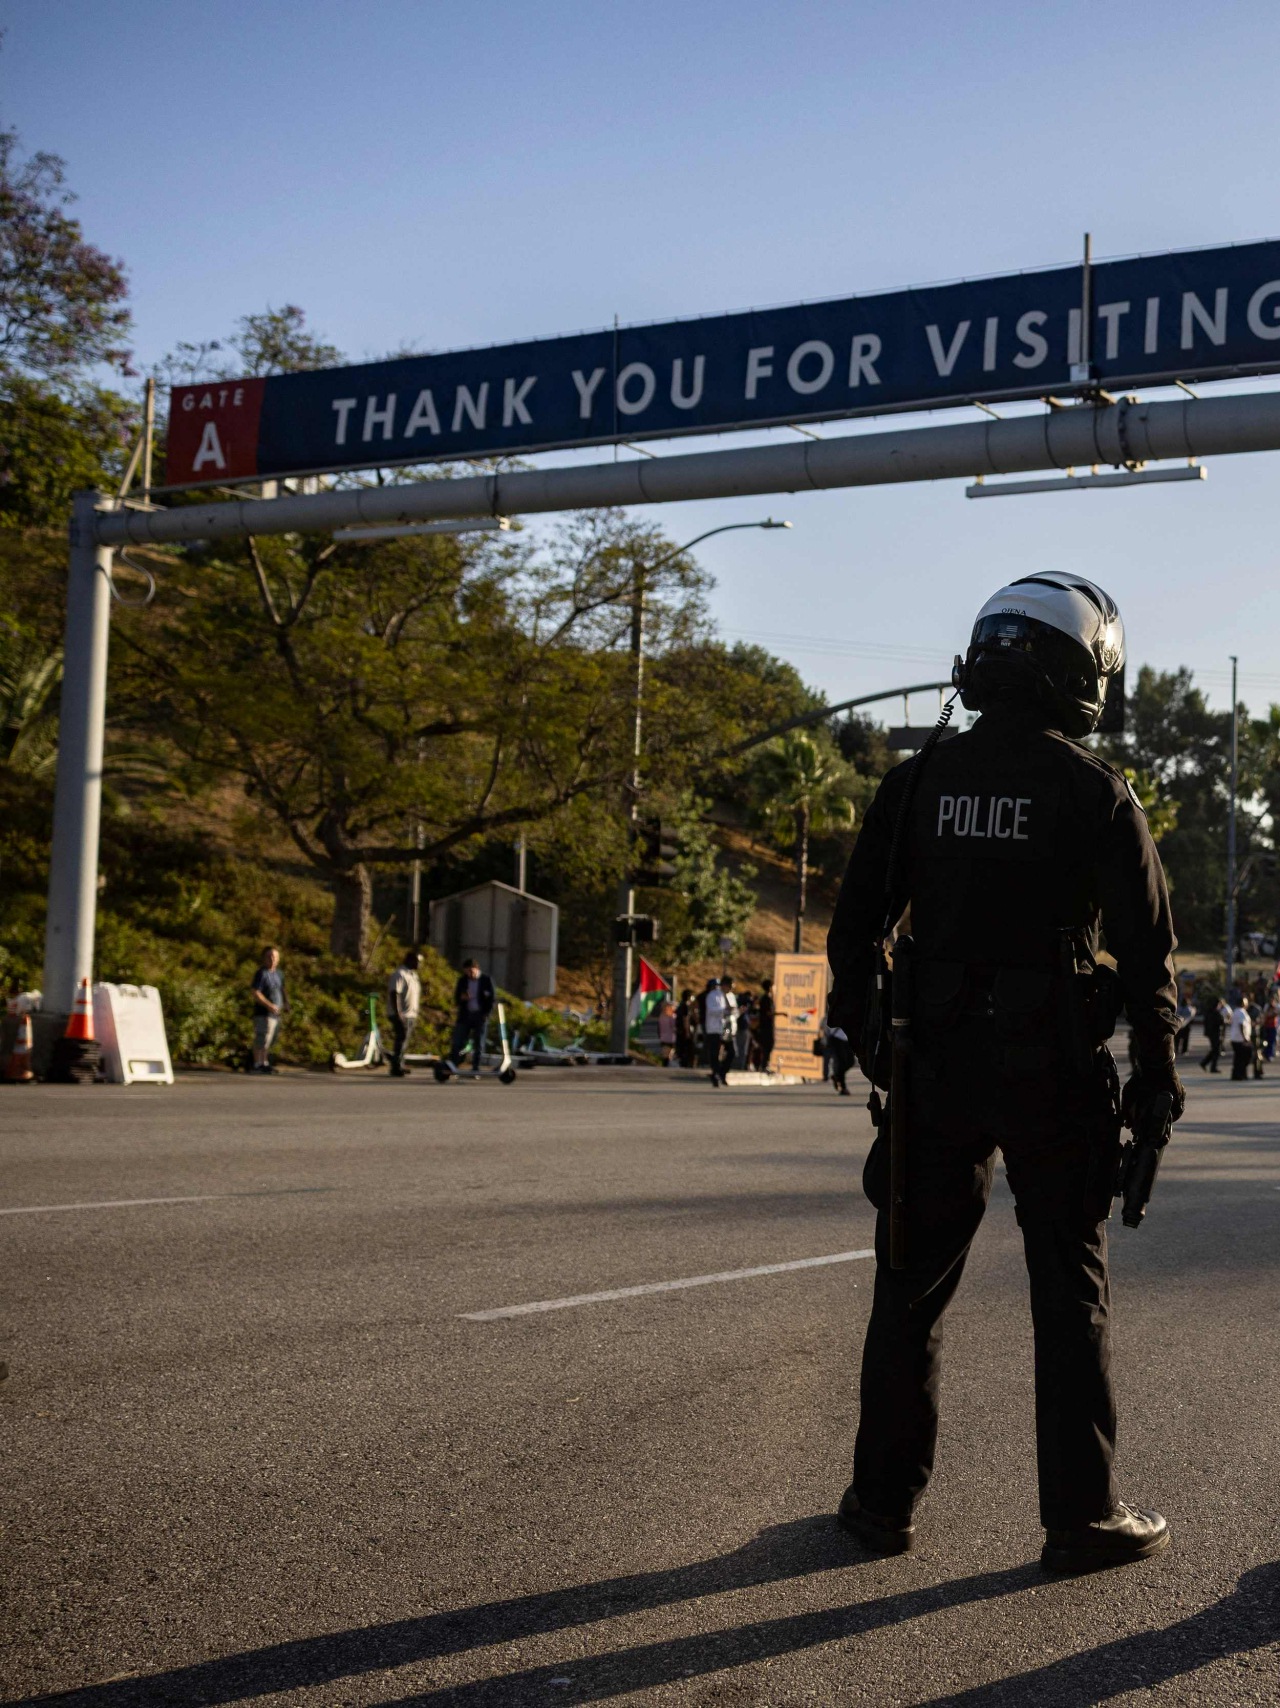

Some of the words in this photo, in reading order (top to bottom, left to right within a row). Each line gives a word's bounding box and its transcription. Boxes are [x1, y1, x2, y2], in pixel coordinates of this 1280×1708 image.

[182, 388, 245, 412] GATE
[333, 376, 538, 445] THANK
[571, 356, 705, 419] YOU
[744, 334, 882, 400] FOR
[192, 422, 226, 472] A
[937, 795, 1032, 840] POLICE
